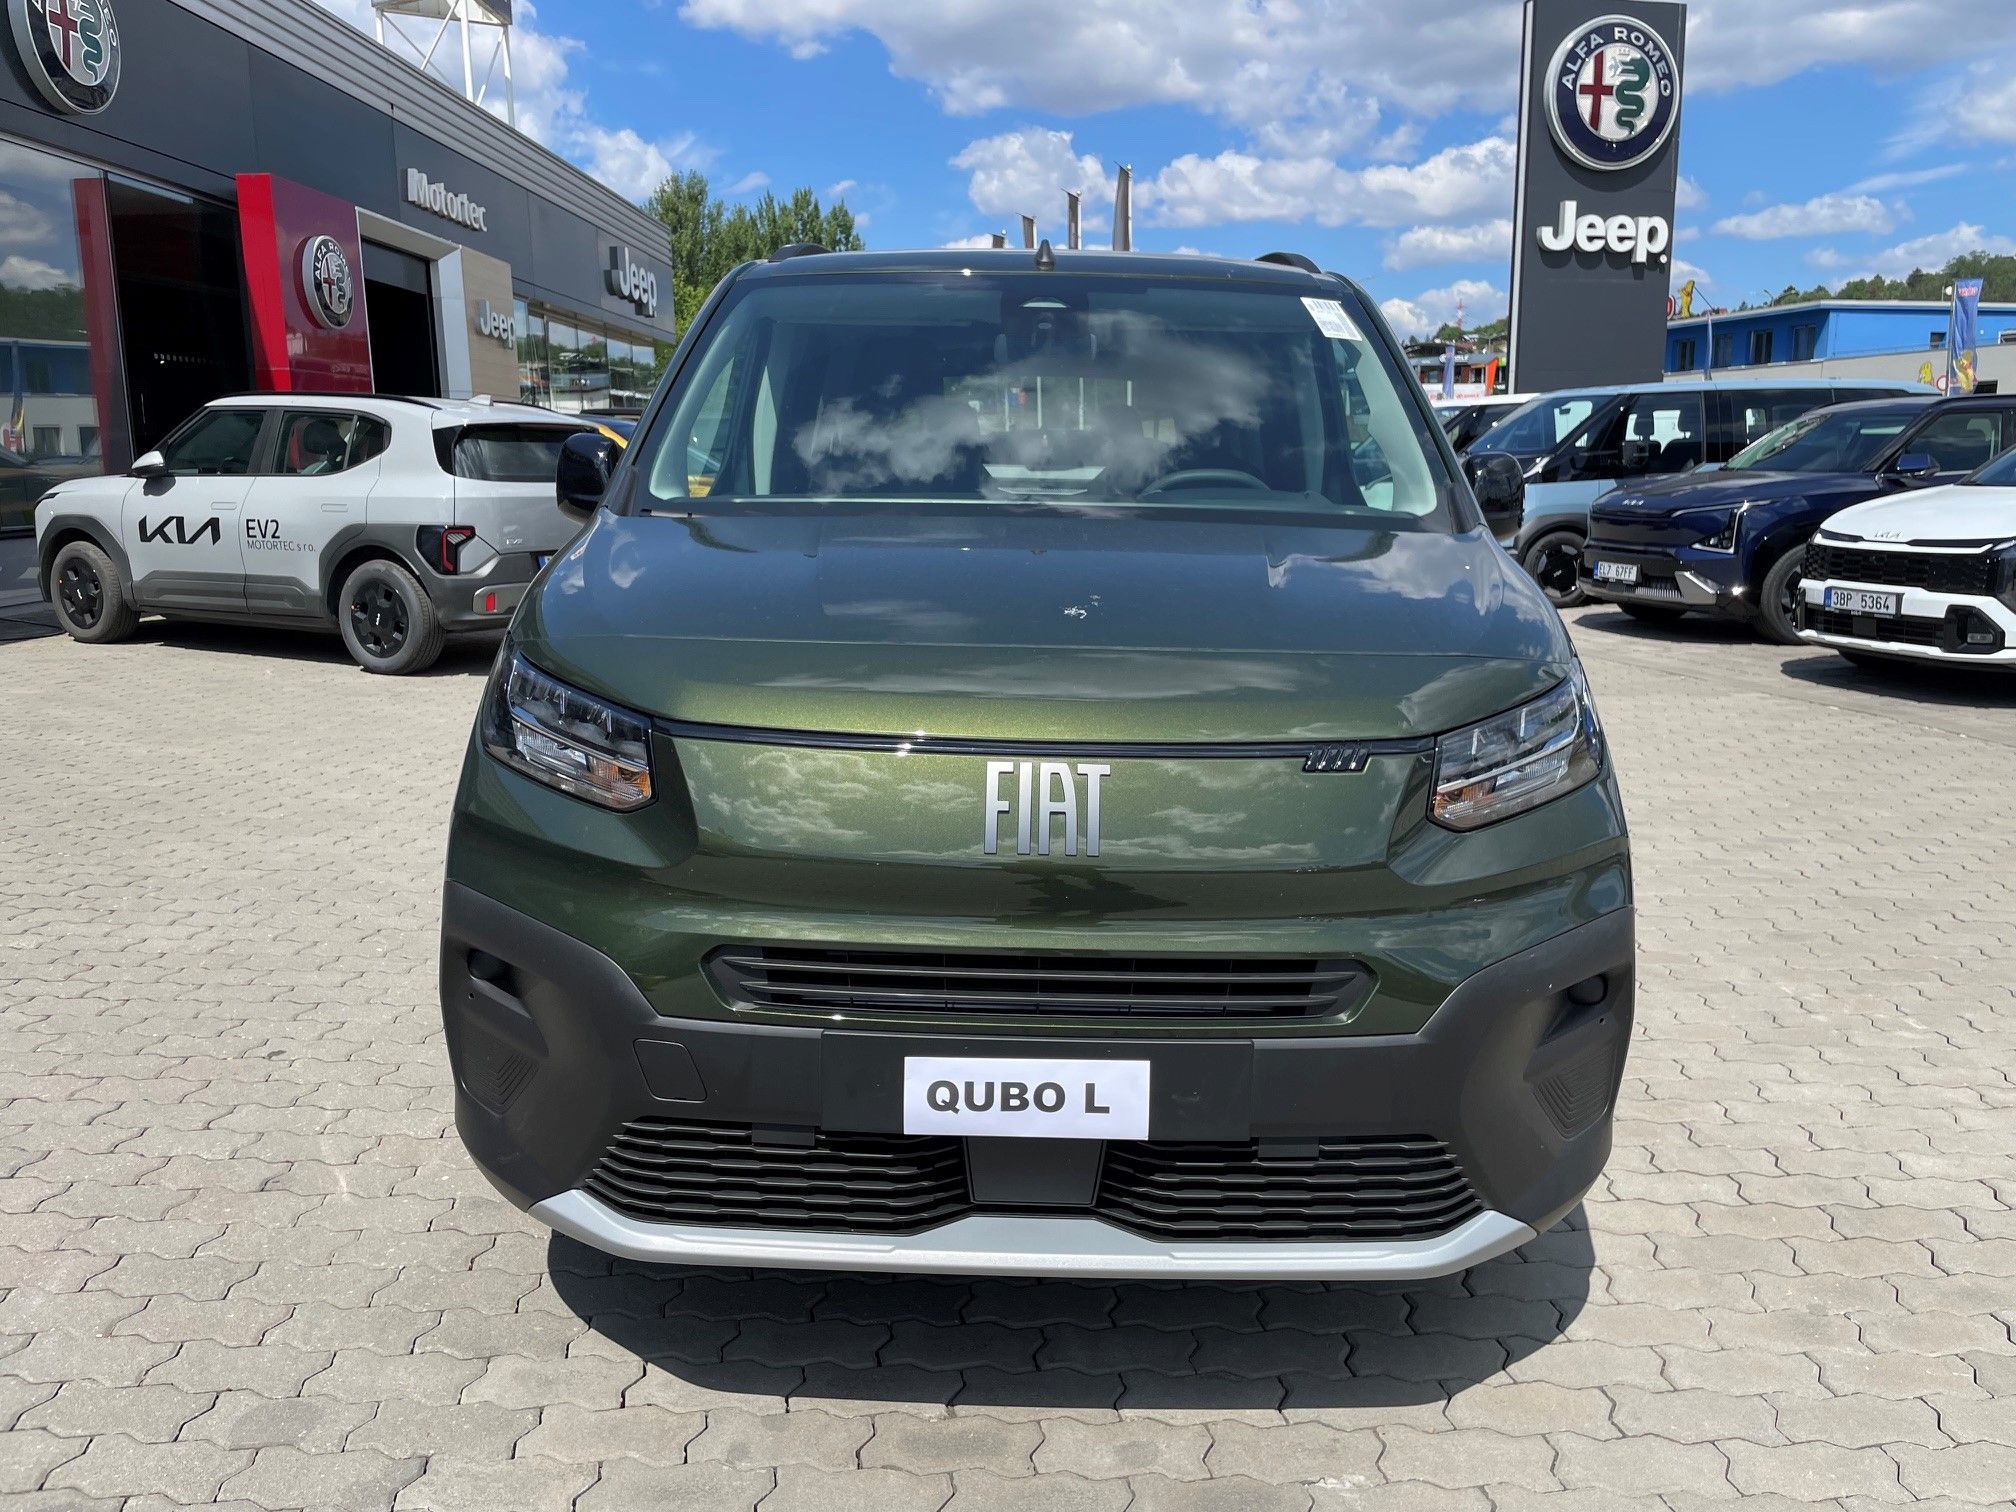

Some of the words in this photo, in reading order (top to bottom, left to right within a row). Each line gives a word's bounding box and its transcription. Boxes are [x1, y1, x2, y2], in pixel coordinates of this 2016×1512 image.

[1562, 33, 1604, 91] ALFA
[1614, 27, 1671, 97] ROMEO
[407, 168, 488, 232] Motortec
[314, 244, 327, 280] ALFA
[618, 246, 658, 317] Jeep
[479, 299, 515, 348] Jeep
[138, 515, 221, 546] KIA
[246, 519, 280, 539] EV2
[247, 541, 295, 551] MOTORTEC
[1833, 591, 1853, 607] 3BP
[1860, 594, 1890, 611] 5364
[984, 761, 1111, 857] FIAT
[926, 1080, 1066, 1114] QUBO
[1084, 1082, 1110, 1114] L
